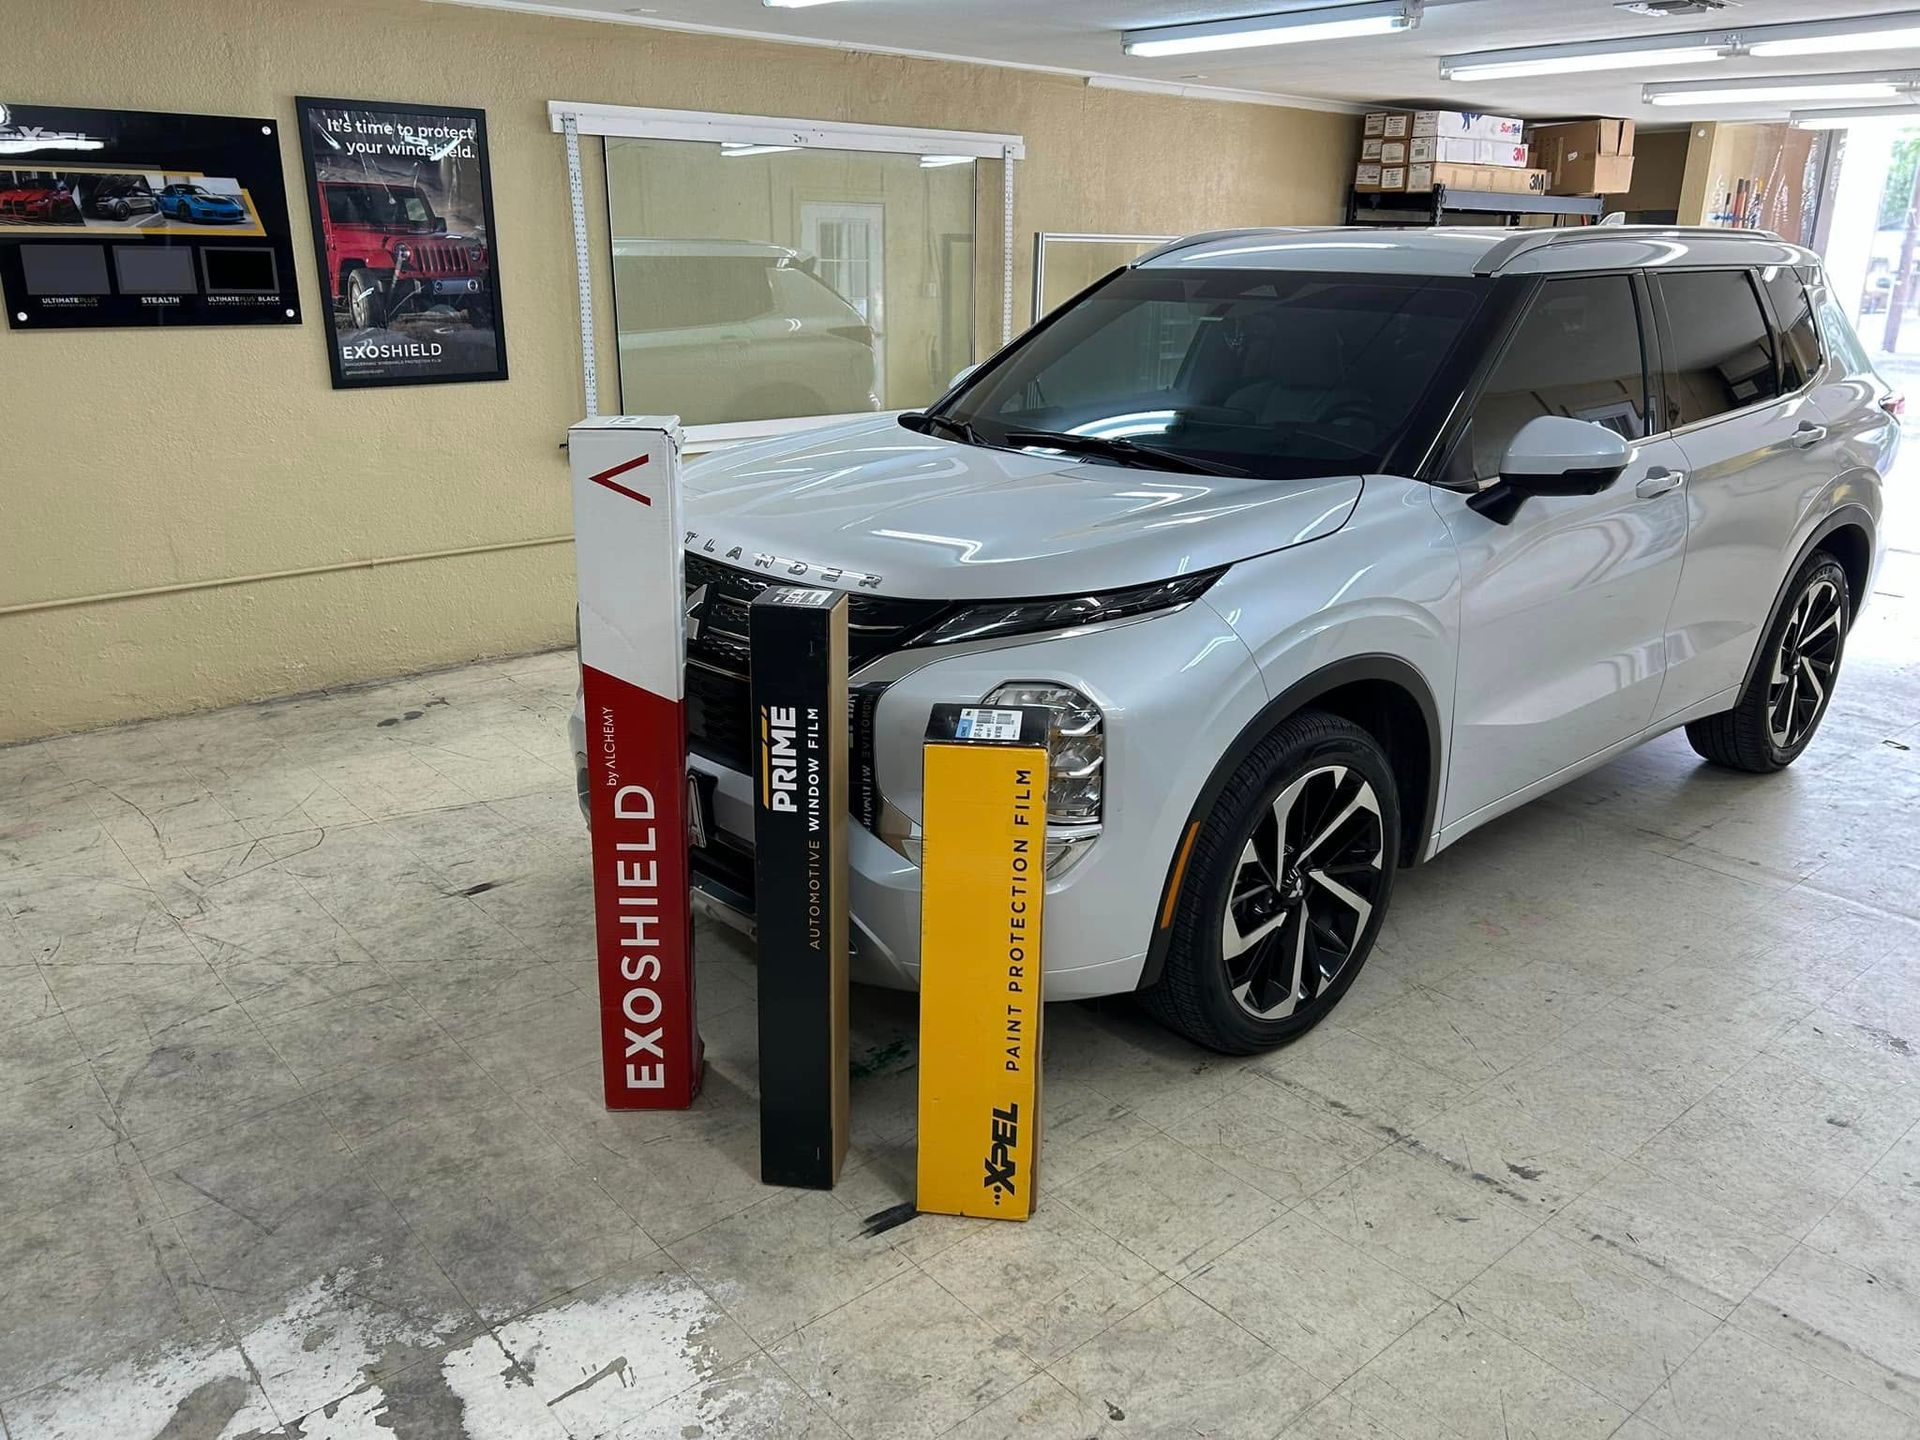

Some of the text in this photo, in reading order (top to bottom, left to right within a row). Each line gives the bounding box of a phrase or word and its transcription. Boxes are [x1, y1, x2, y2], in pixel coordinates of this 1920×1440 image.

[326, 118, 474, 141] It's time to protect
[1500, 122, 1521, 134] SunTek
[345, 141, 384, 156] your
[1513, 147, 1526, 162] 3M
[1530, 173, 1544, 191] 3M
[141, 296, 180, 304] STEALTH
[342, 343, 442, 360] EXOSHIELD
[684, 530, 884, 590] TLANDER
[770, 706, 798, 813] PRIME
[606, 771, 620, 786] by
[807, 708, 821, 950] AUTOMOTIVE WINDOW FILM
[1005, 770, 1031, 1072] PAINT PROTECTION FILM
[614, 785, 665, 1089] EXOSHIELD
[983, 1102, 1018, 1196] XPEL
